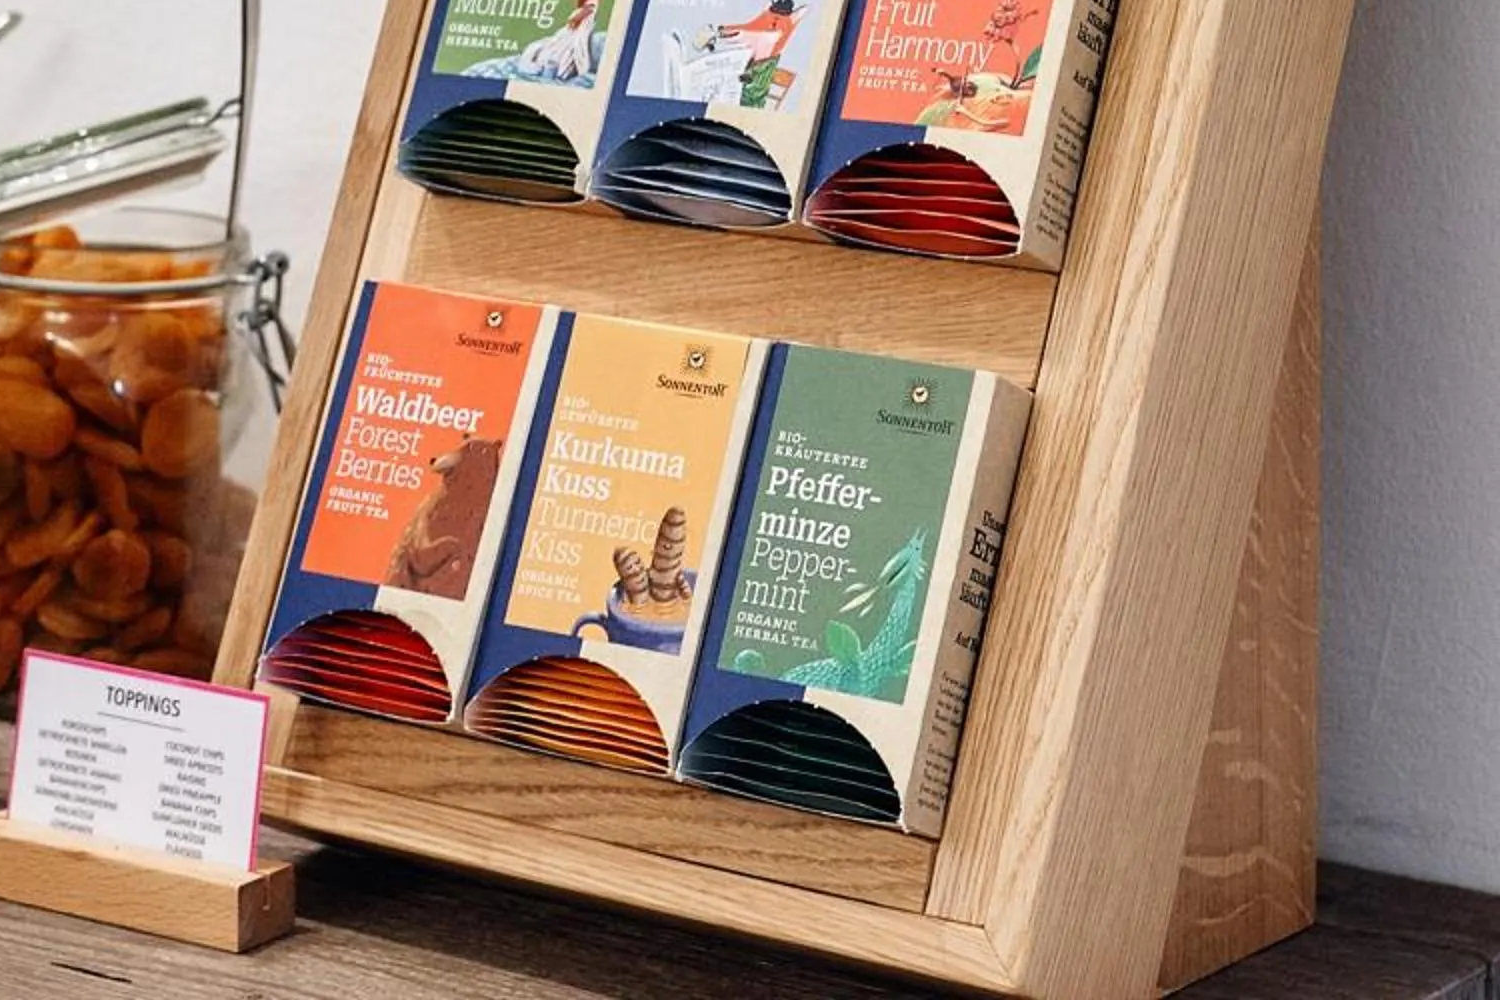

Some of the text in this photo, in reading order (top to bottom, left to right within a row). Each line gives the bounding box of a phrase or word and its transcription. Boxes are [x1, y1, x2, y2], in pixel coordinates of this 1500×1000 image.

[445, 36, 519, 51] HERBAL TEA
[449, 22, 503, 36] ORGANIC
[865, 25, 996, 73] Harmony
[857, 77, 928, 93] FRUIT TEA
[859, 64, 920, 81] ORGANIC
[355, 384, 484, 433] Waldbeer
[343, 415, 424, 457] Forest
[550, 429, 686, 480] Kurkuma
[778, 429, 808, 445] BIO-
[335, 448, 425, 490] Berries
[774, 443, 870, 470] KRÄUTERTEE
[329, 486, 386, 505] ORGANIC
[542, 463, 613, 502] Kuss
[765, 465, 883, 511] Pfeffer-
[325, 499, 389, 520] FRUIT TEA
[537, 496, 658, 545] Turmeric
[756, 506, 852, 549] minze
[526, 529, 584, 568] Kiss
[749, 537, 859, 584] Pepper-
[741, 576, 811, 615] mint
[734, 625, 818, 651] HERBAL TEA
[737, 610, 799, 631] ORGANIC
[105, 685, 182, 718] TOPPINGS
